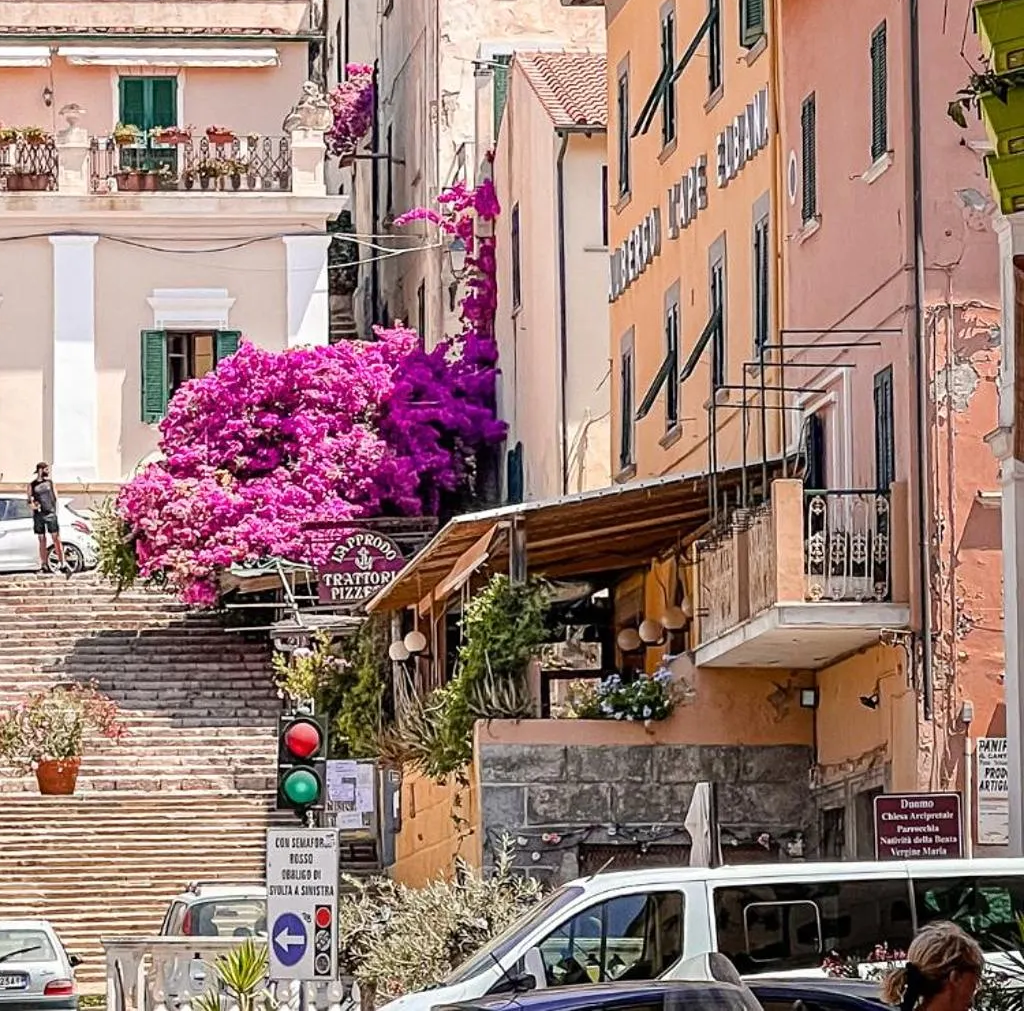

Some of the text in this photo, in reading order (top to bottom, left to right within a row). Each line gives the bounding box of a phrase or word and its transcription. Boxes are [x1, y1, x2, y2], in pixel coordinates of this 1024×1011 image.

[608, 82, 769, 303] ALBERGO L'APE ELBANA
[322, 571, 396, 586] TRATTORI
[331, 585, 382, 600] PIZZE
[979, 780, 1008, 792] ARTIGI
[900, 799, 934, 809] Duomo
[881, 811, 953, 821] Chiesa Arcipretale
[896, 825, 939, 833] Parrocchia
[275, 837, 332, 848] CON SEMAFOR
[913, 835, 933, 844] della
[935, 834, 957, 843] Beata
[890, 847, 947, 857] Vergine Maria
[289, 853, 314, 864] ROSSO
[282, 869, 322, 880] OBBLIGO DI
[269, 885, 334, 896] SVOLTA A SINISTRA
